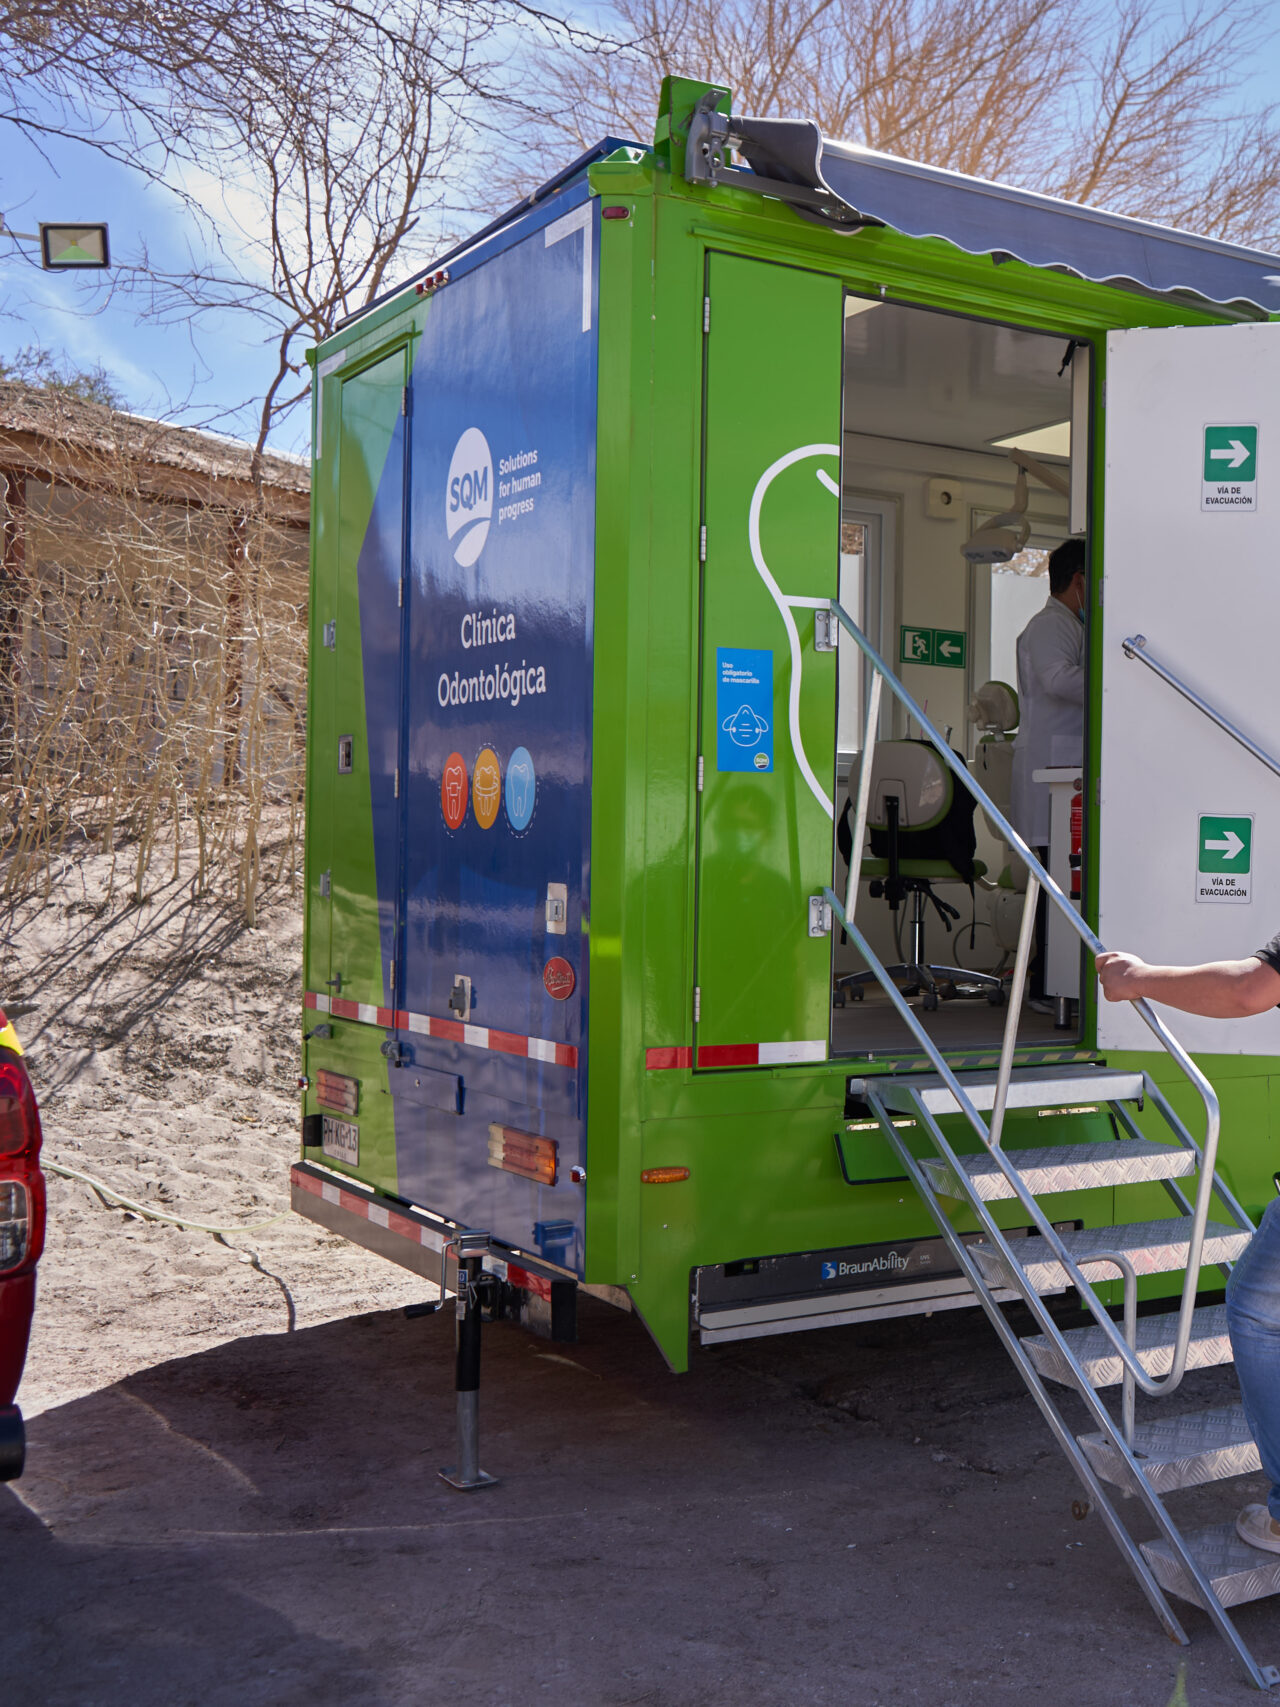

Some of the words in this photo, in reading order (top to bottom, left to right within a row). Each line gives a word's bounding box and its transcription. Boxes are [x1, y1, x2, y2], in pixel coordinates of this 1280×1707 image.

[499, 450, 538, 475] Solutions
[450, 466, 488, 512] SQM
[499, 482, 510, 498] for
[512, 472, 541, 494] human
[1217, 485, 1229, 494] VÍA
[499, 497, 534, 524] progress
[1205, 496, 1252, 504] EVACUACIÓN
[460, 608, 516, 649] Clínica
[438, 660, 546, 707] Odontológica
[722, 669, 753, 677] obligatorio
[1200, 888, 1247, 897] EVACUACIÓN
[1212, 876, 1223, 886] VÍA
[1225, 878, 1236, 886] DE
[838, 1251, 910, 1276] BraunAbility
